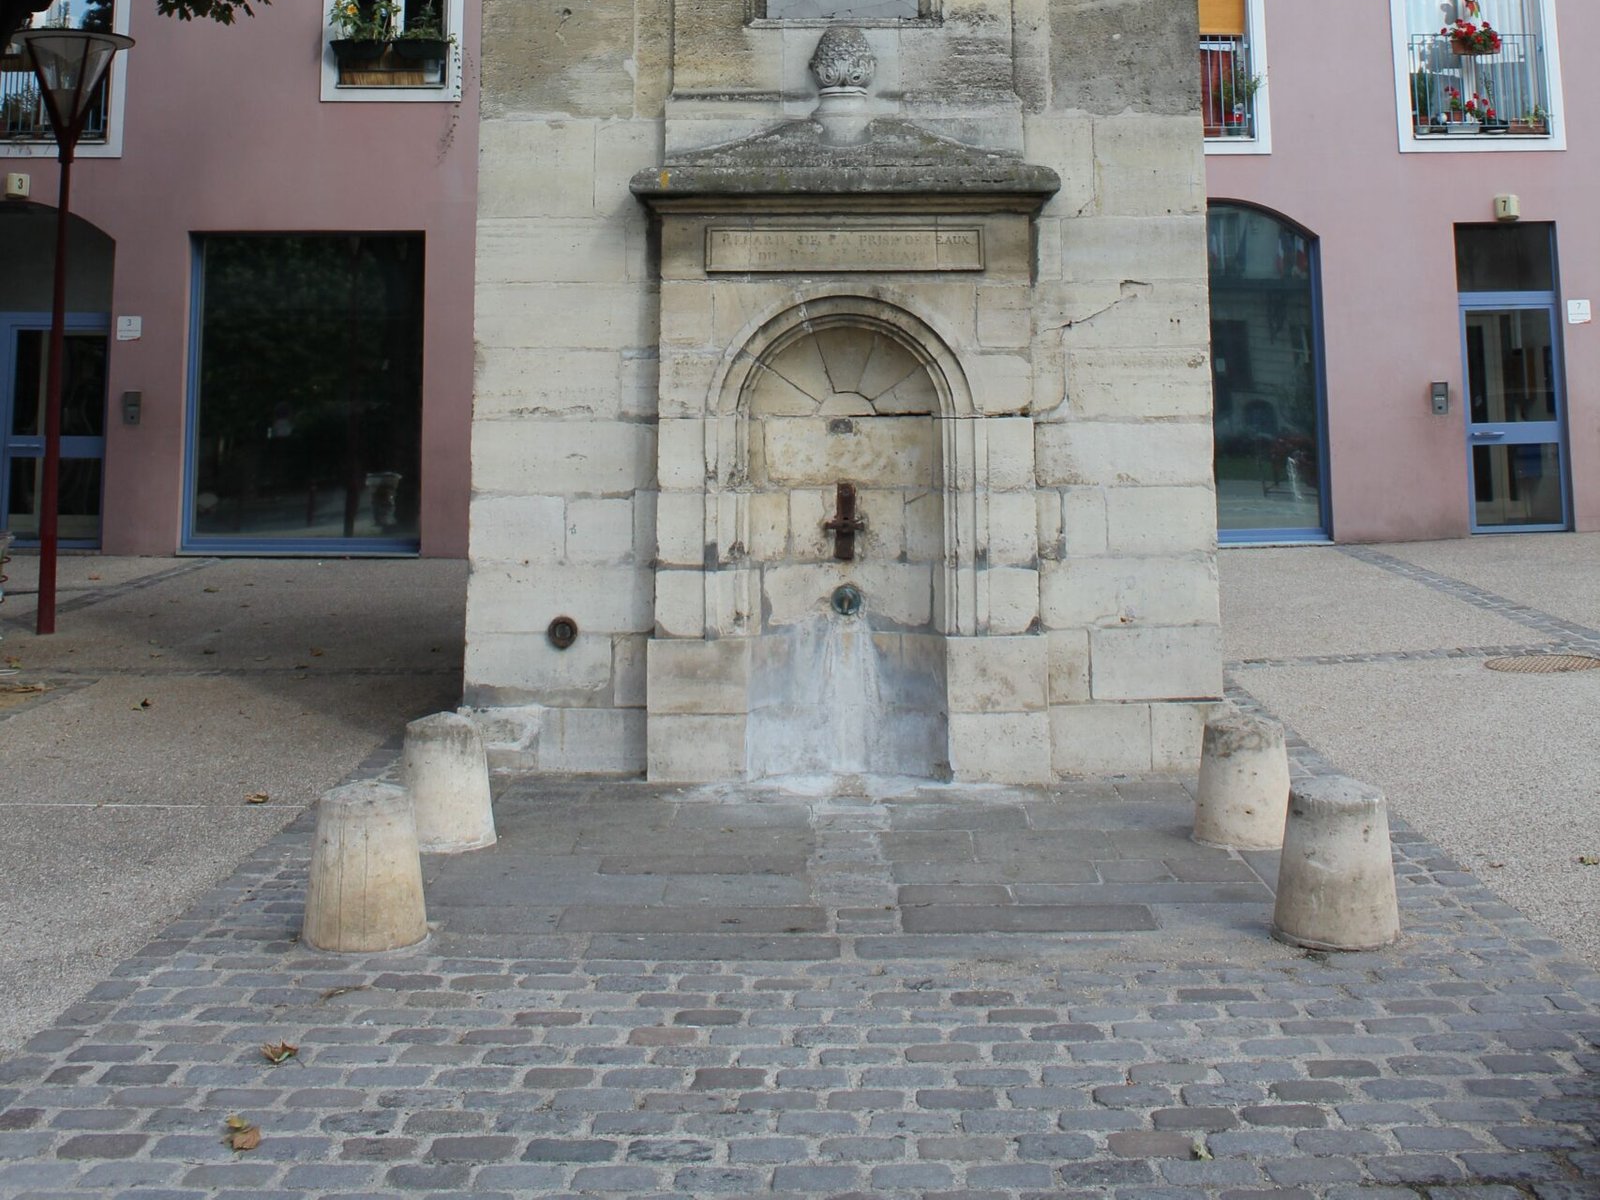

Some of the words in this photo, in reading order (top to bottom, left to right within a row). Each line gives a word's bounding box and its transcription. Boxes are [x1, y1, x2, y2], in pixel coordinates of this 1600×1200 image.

[17, 177, 24, 190] 3
[1501, 200, 1507, 212] 7
[936, 235, 970, 247] EAUX
